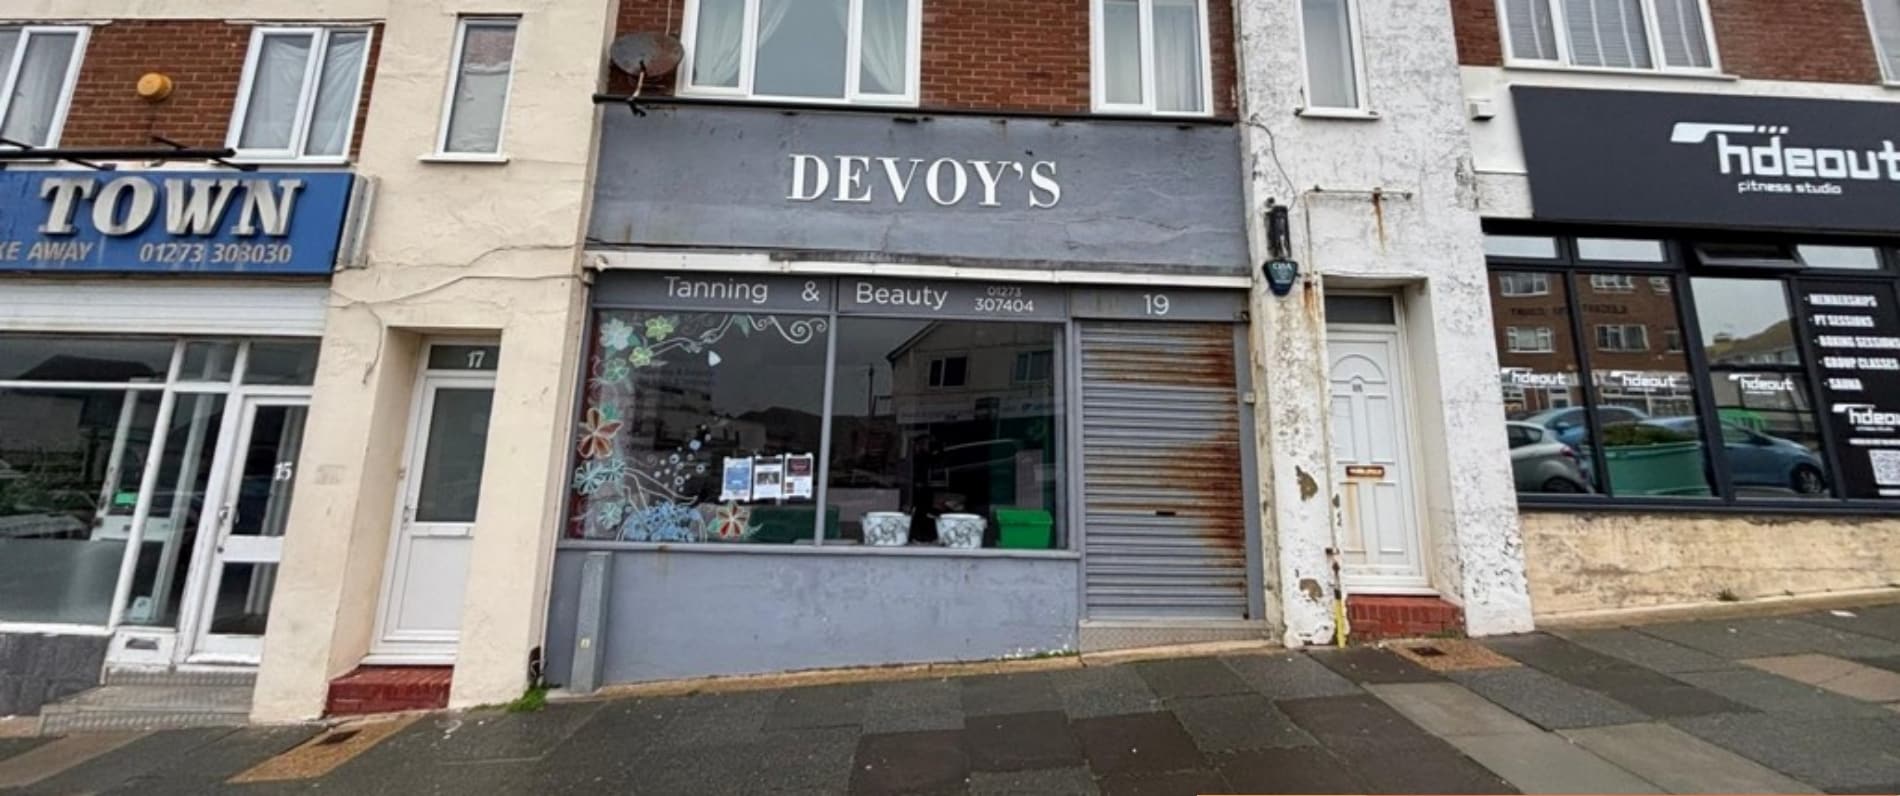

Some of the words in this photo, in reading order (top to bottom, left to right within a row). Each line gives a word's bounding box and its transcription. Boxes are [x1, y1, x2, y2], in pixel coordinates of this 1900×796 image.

[786, 154, 1061, 209] DEVOY'S
[1738, 179, 1792, 193] fitness
[1795, 181, 1842, 195] studio
[38, 176, 303, 236] TOWN
[26, 241, 95, 261] AWAY
[139, 243, 203, 263] 01273
[664, 276, 769, 304] Tanning
[801, 281, 820, 301] &
[856, 282, 949, 311] Beauty
[987, 286, 1023, 297] 01273
[974, 297, 1035, 312] 307404
[1143, 294, 1170, 315] 19
[467, 350, 486, 369] 17
[275, 461, 293, 480] 15
